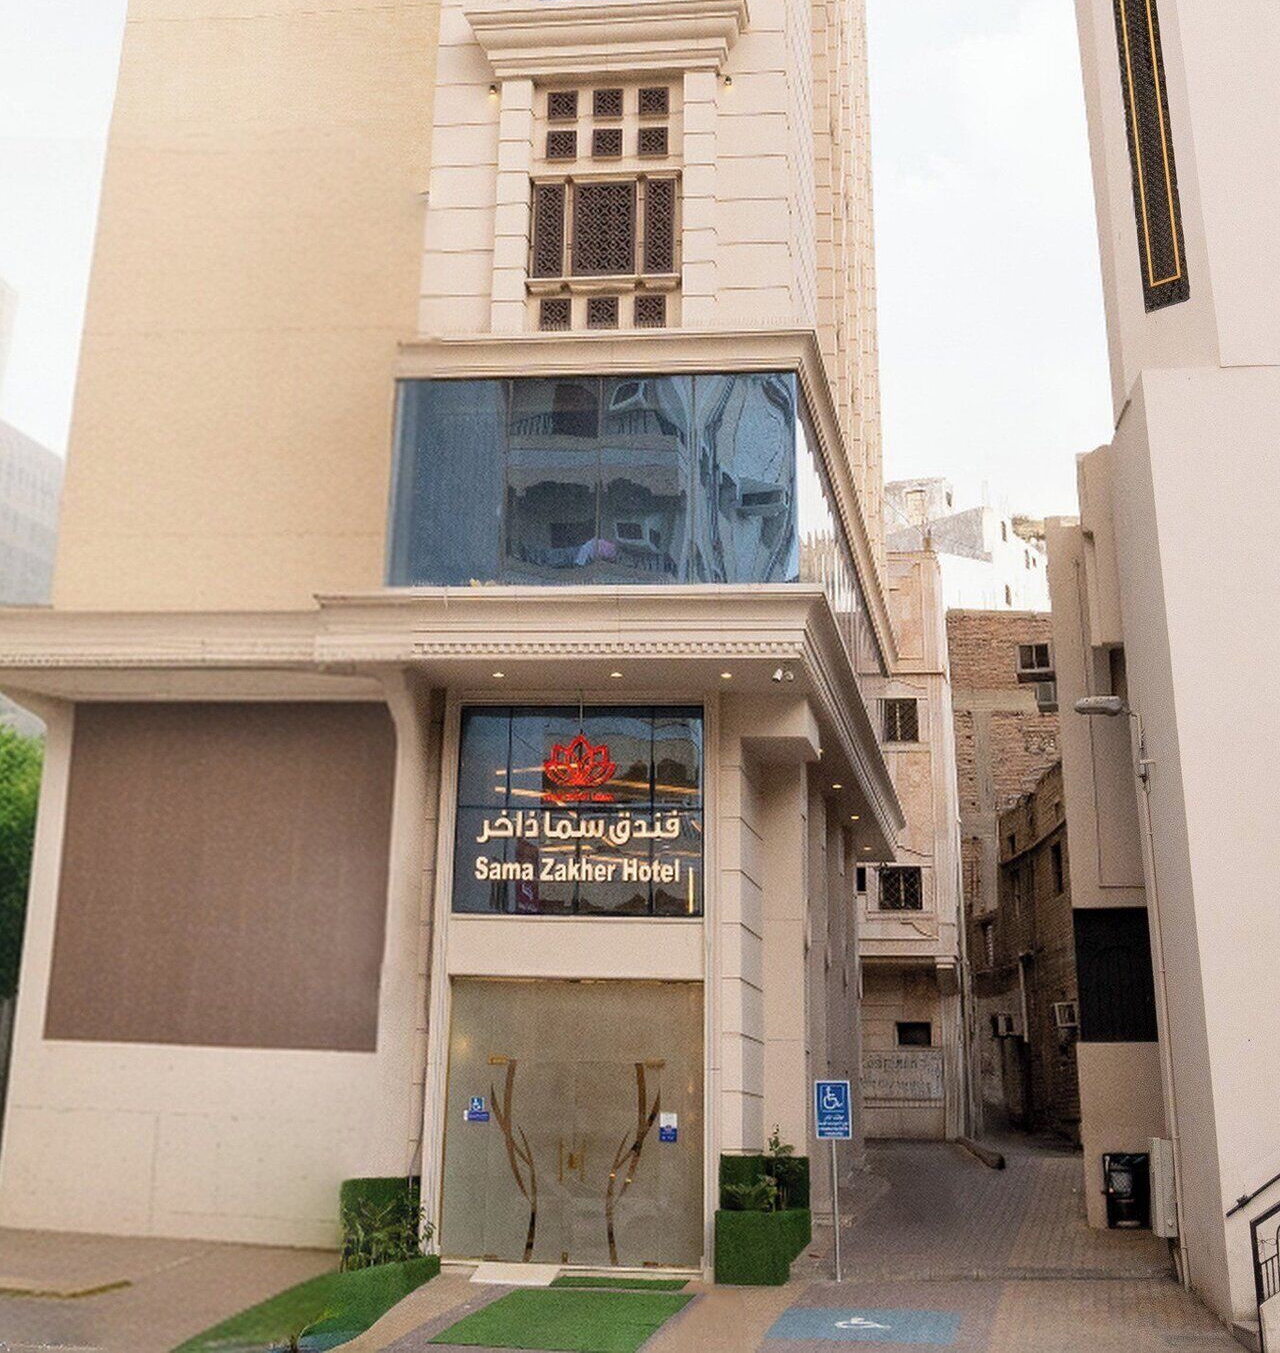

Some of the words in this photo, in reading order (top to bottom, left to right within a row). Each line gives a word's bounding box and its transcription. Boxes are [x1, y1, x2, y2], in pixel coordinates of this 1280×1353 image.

[475, 809, 539, 843] ذاخر
[544, 810, 605, 839] سما
[608, 809, 681, 845] فندق
[474, 856, 534, 881] Sama
[539, 857, 617, 882] Zakher
[622, 857, 681, 883] Hotel
